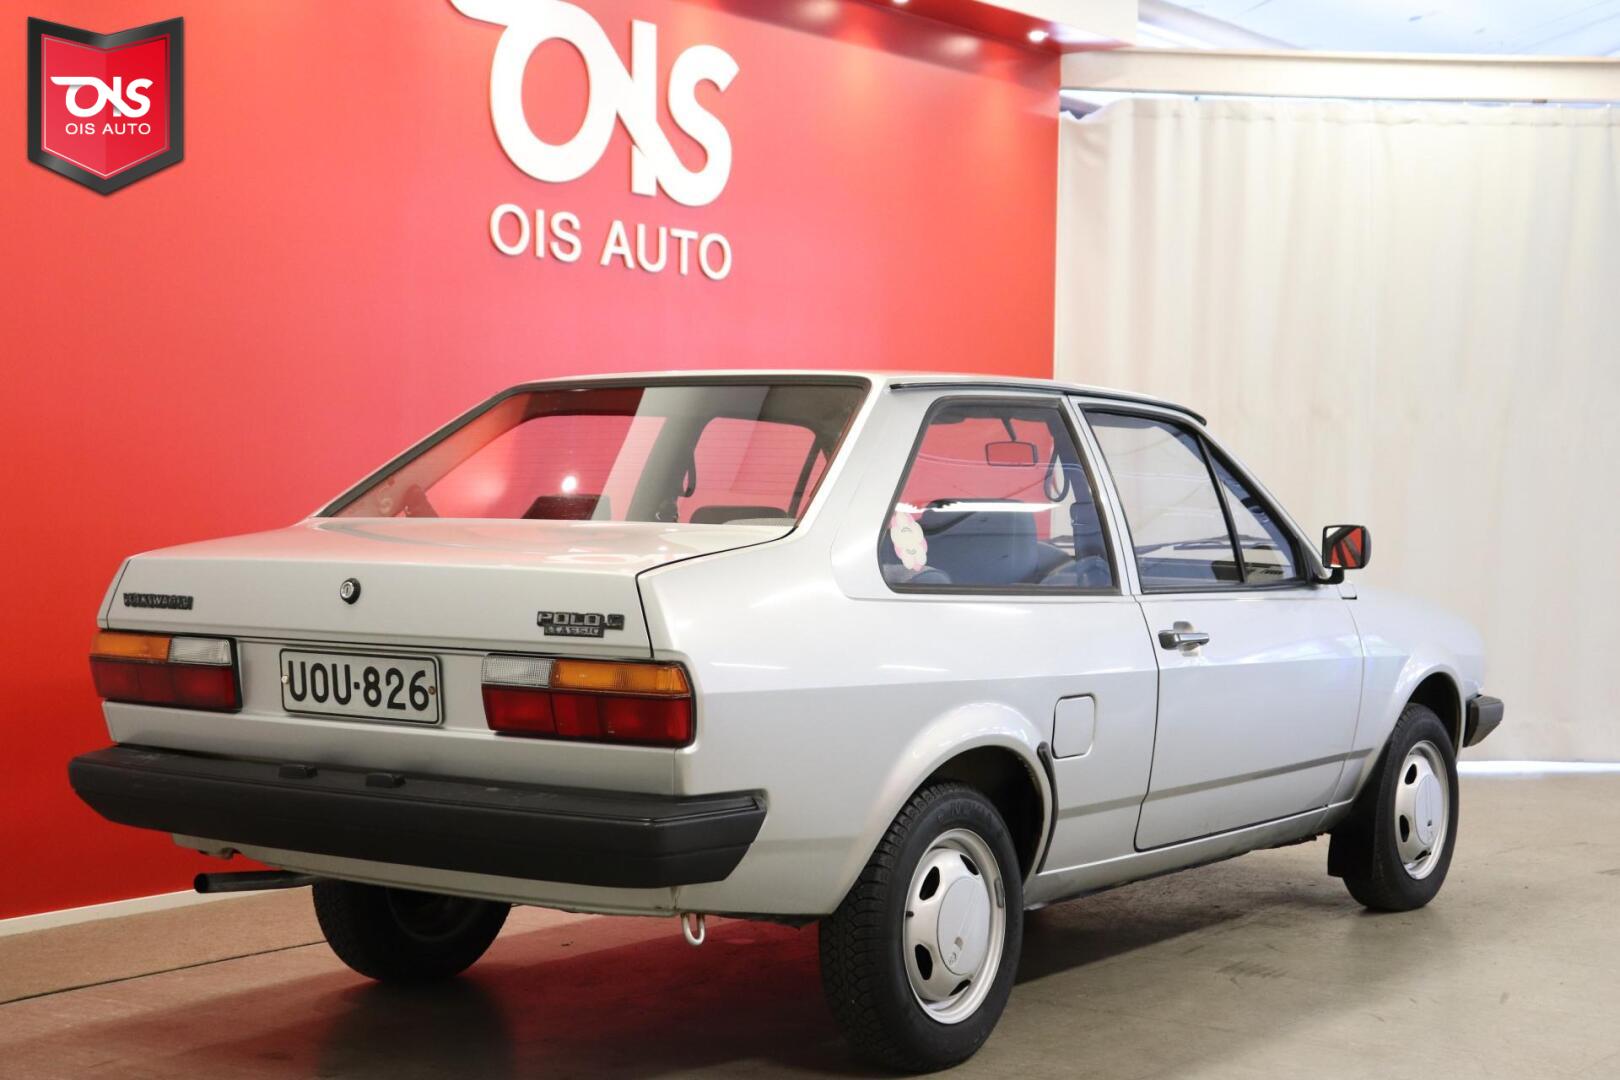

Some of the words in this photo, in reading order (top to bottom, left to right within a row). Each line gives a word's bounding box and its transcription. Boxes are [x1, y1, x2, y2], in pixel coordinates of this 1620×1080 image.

[489, 203, 582, 263] OIS
[600, 219, 733, 281] AUTO
[537, 611, 605, 627] POLO
